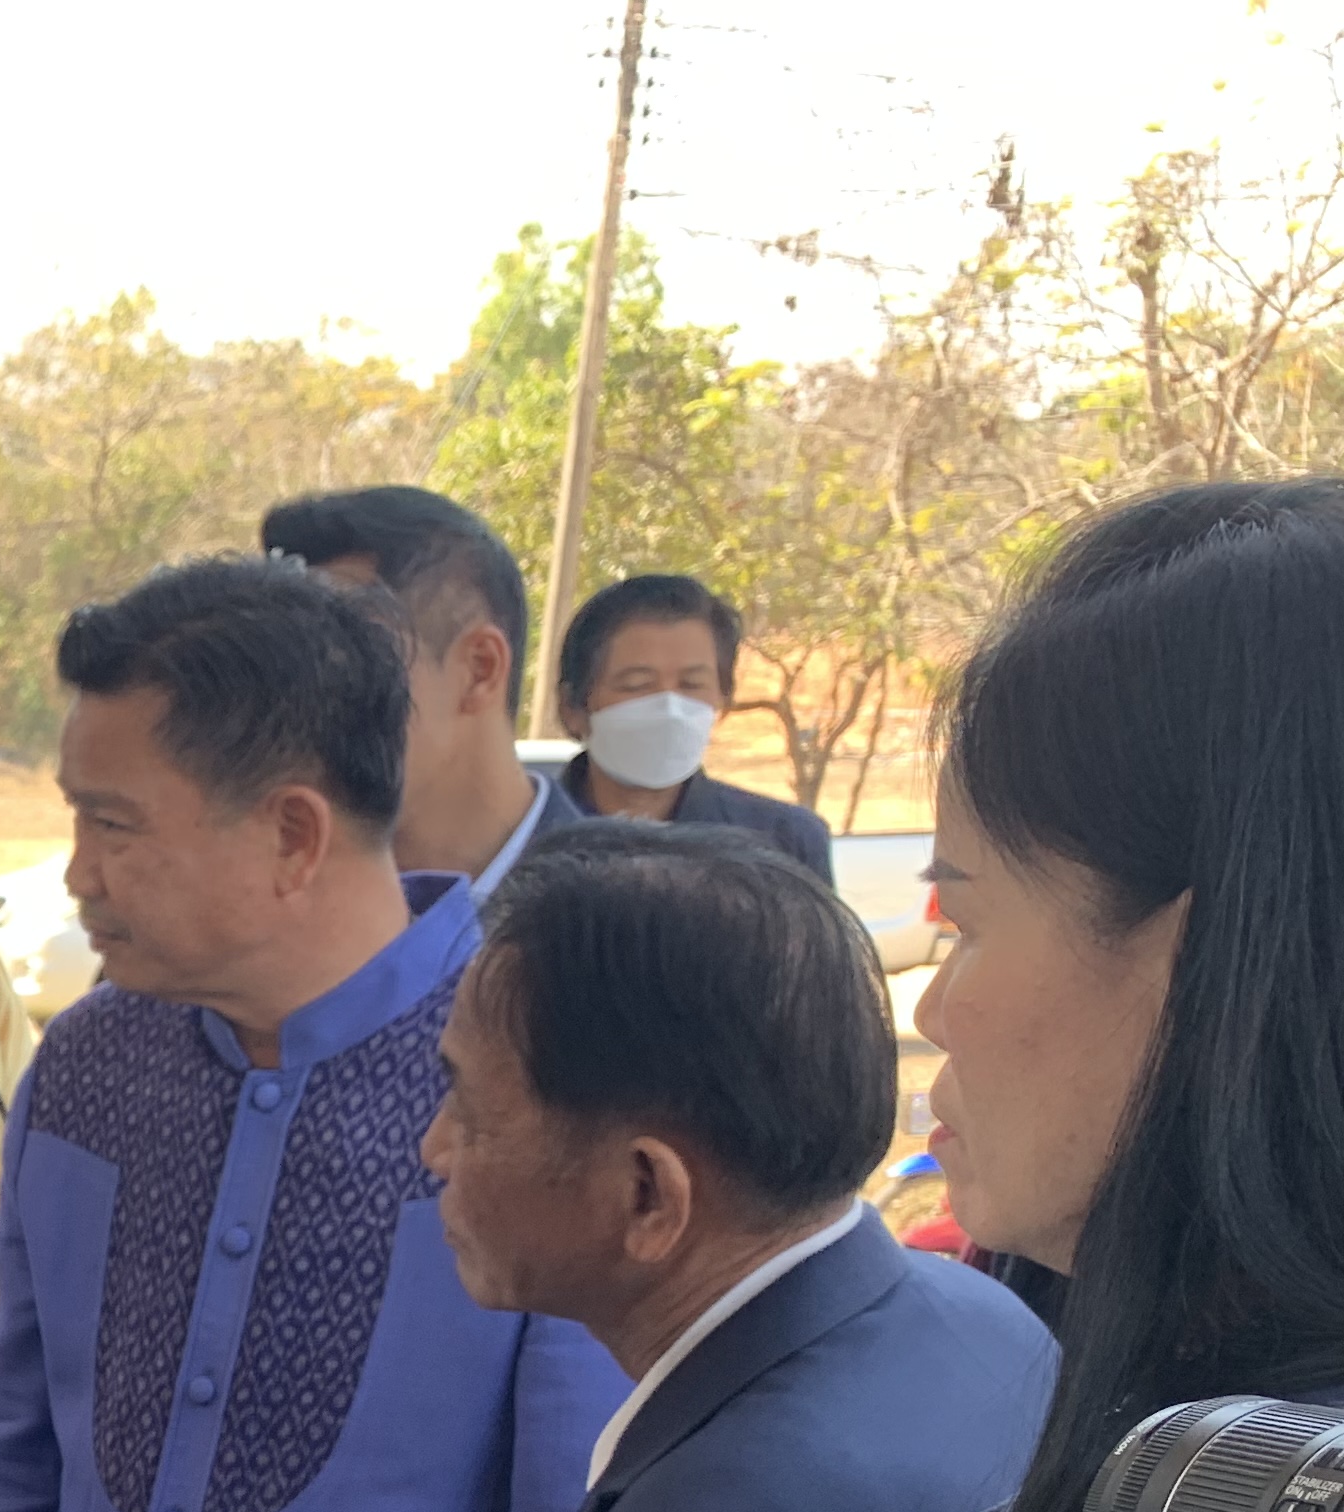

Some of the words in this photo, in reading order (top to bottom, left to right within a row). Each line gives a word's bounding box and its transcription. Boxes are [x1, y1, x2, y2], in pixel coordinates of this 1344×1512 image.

[1114, 1433, 1137, 1457] HOYA
[1285, 1485, 1302, 1496] ON
[1311, 1489, 1331, 1501] OFF
[1290, 1475, 1344, 1493] STABILIZER
